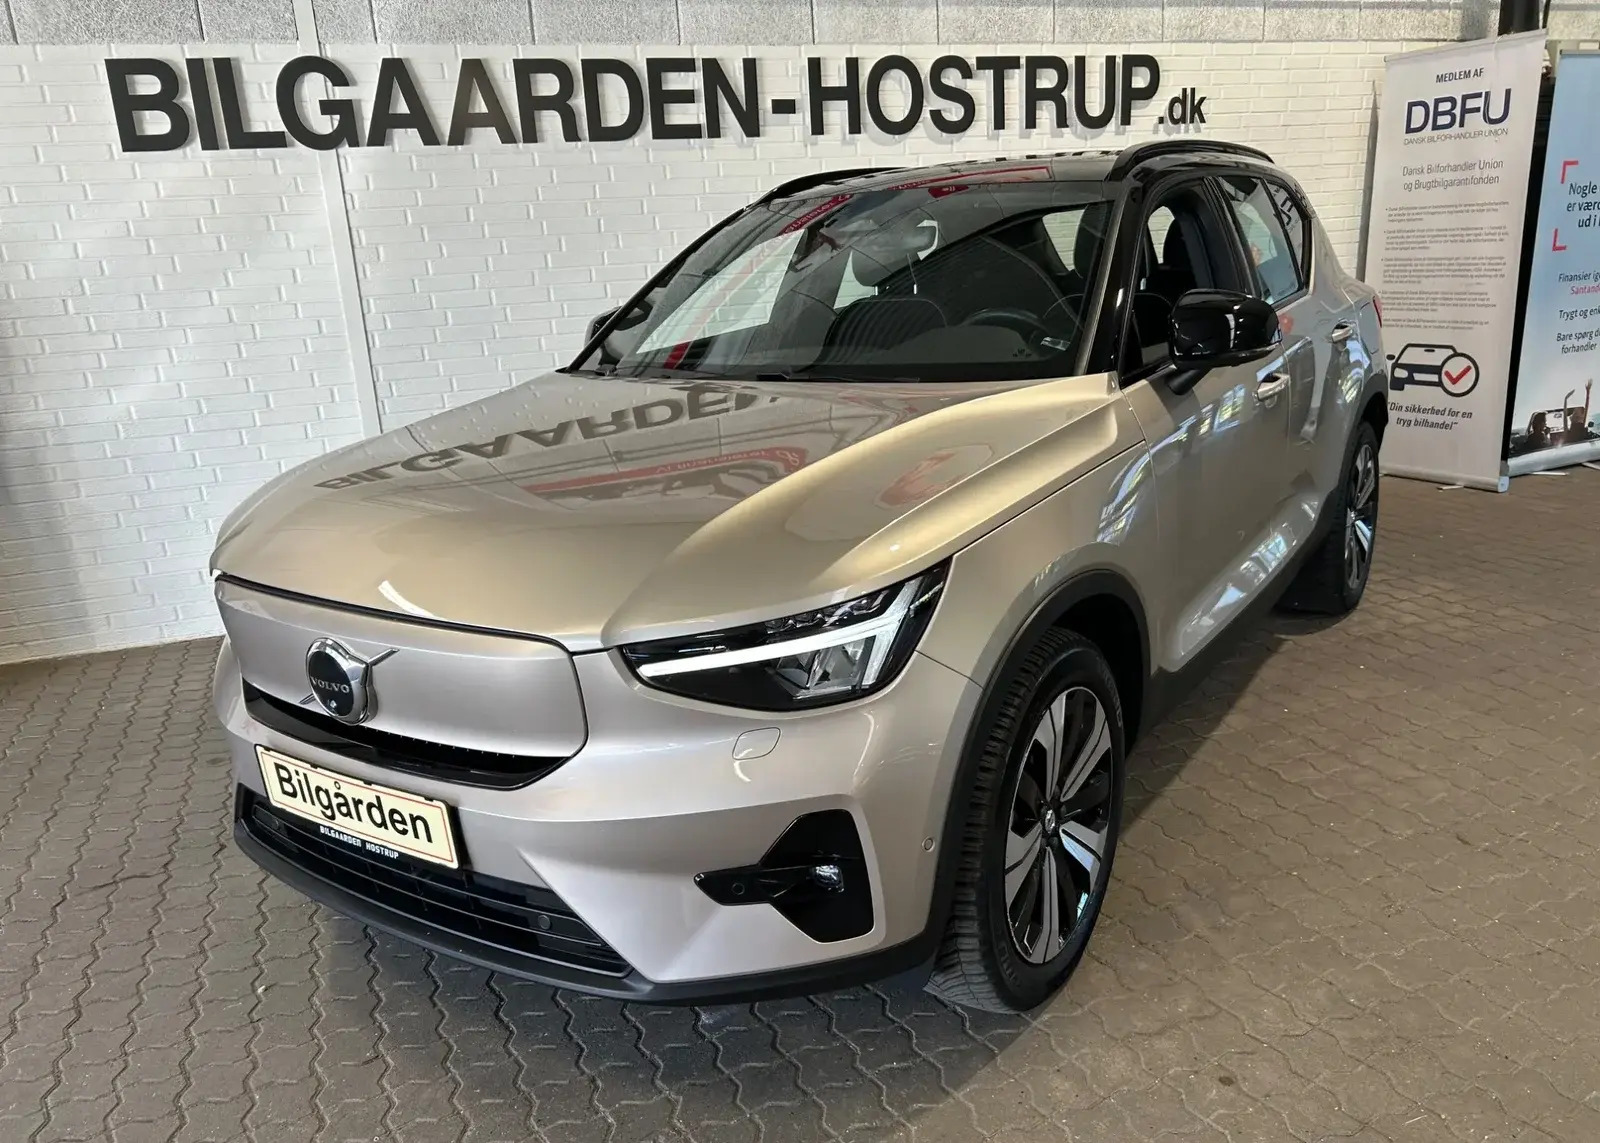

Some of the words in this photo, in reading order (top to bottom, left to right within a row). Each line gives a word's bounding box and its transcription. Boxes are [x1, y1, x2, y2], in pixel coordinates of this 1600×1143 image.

[1435, 69, 1471, 83] MEDLEM
[1472, 67, 1484, 78] AF
[1405, 88, 1511, 134] DBFU
[1403, 135, 1426, 146] DANSK
[1427, 130, 1483, 143] BILFORHANDLER
[1484, 128, 1509, 138] UNION
[1402, 165, 1425, 176] Dansk
[1426, 161, 1477, 174] Bilforhandler
[1478, 158, 1504, 171] Union
[1403, 181, 1413, 192] og
[1414, 174, 1500, 191] Brugtbilgarantifonden
[1568, 180, 1598, 198] Nogle
[1566, 202, 1577, 212] er
[1578, 214, 1592, 228] ud
[1558, 271, 1592, 282] Finansier
[1559, 308, 1578, 321] Trygt
[1579, 308, 1588, 319] og
[1556, 332, 1573, 342] Bare
[1574, 330, 1594, 341] spørg
[1561, 341, 1597, 354] forhandler
[1404, 404, 1447, 417] sikkerhed
[1447, 408, 1461, 418] for
[1461, 411, 1473, 419] en
[1396, 416, 1412, 427] tryg
[310, 676, 350, 693] VOLVO
[273, 762, 433, 843] Bilgården
[319, 825, 362, 847] BILGAARDEN
[365, 842, 399, 860] HOSTRUP
